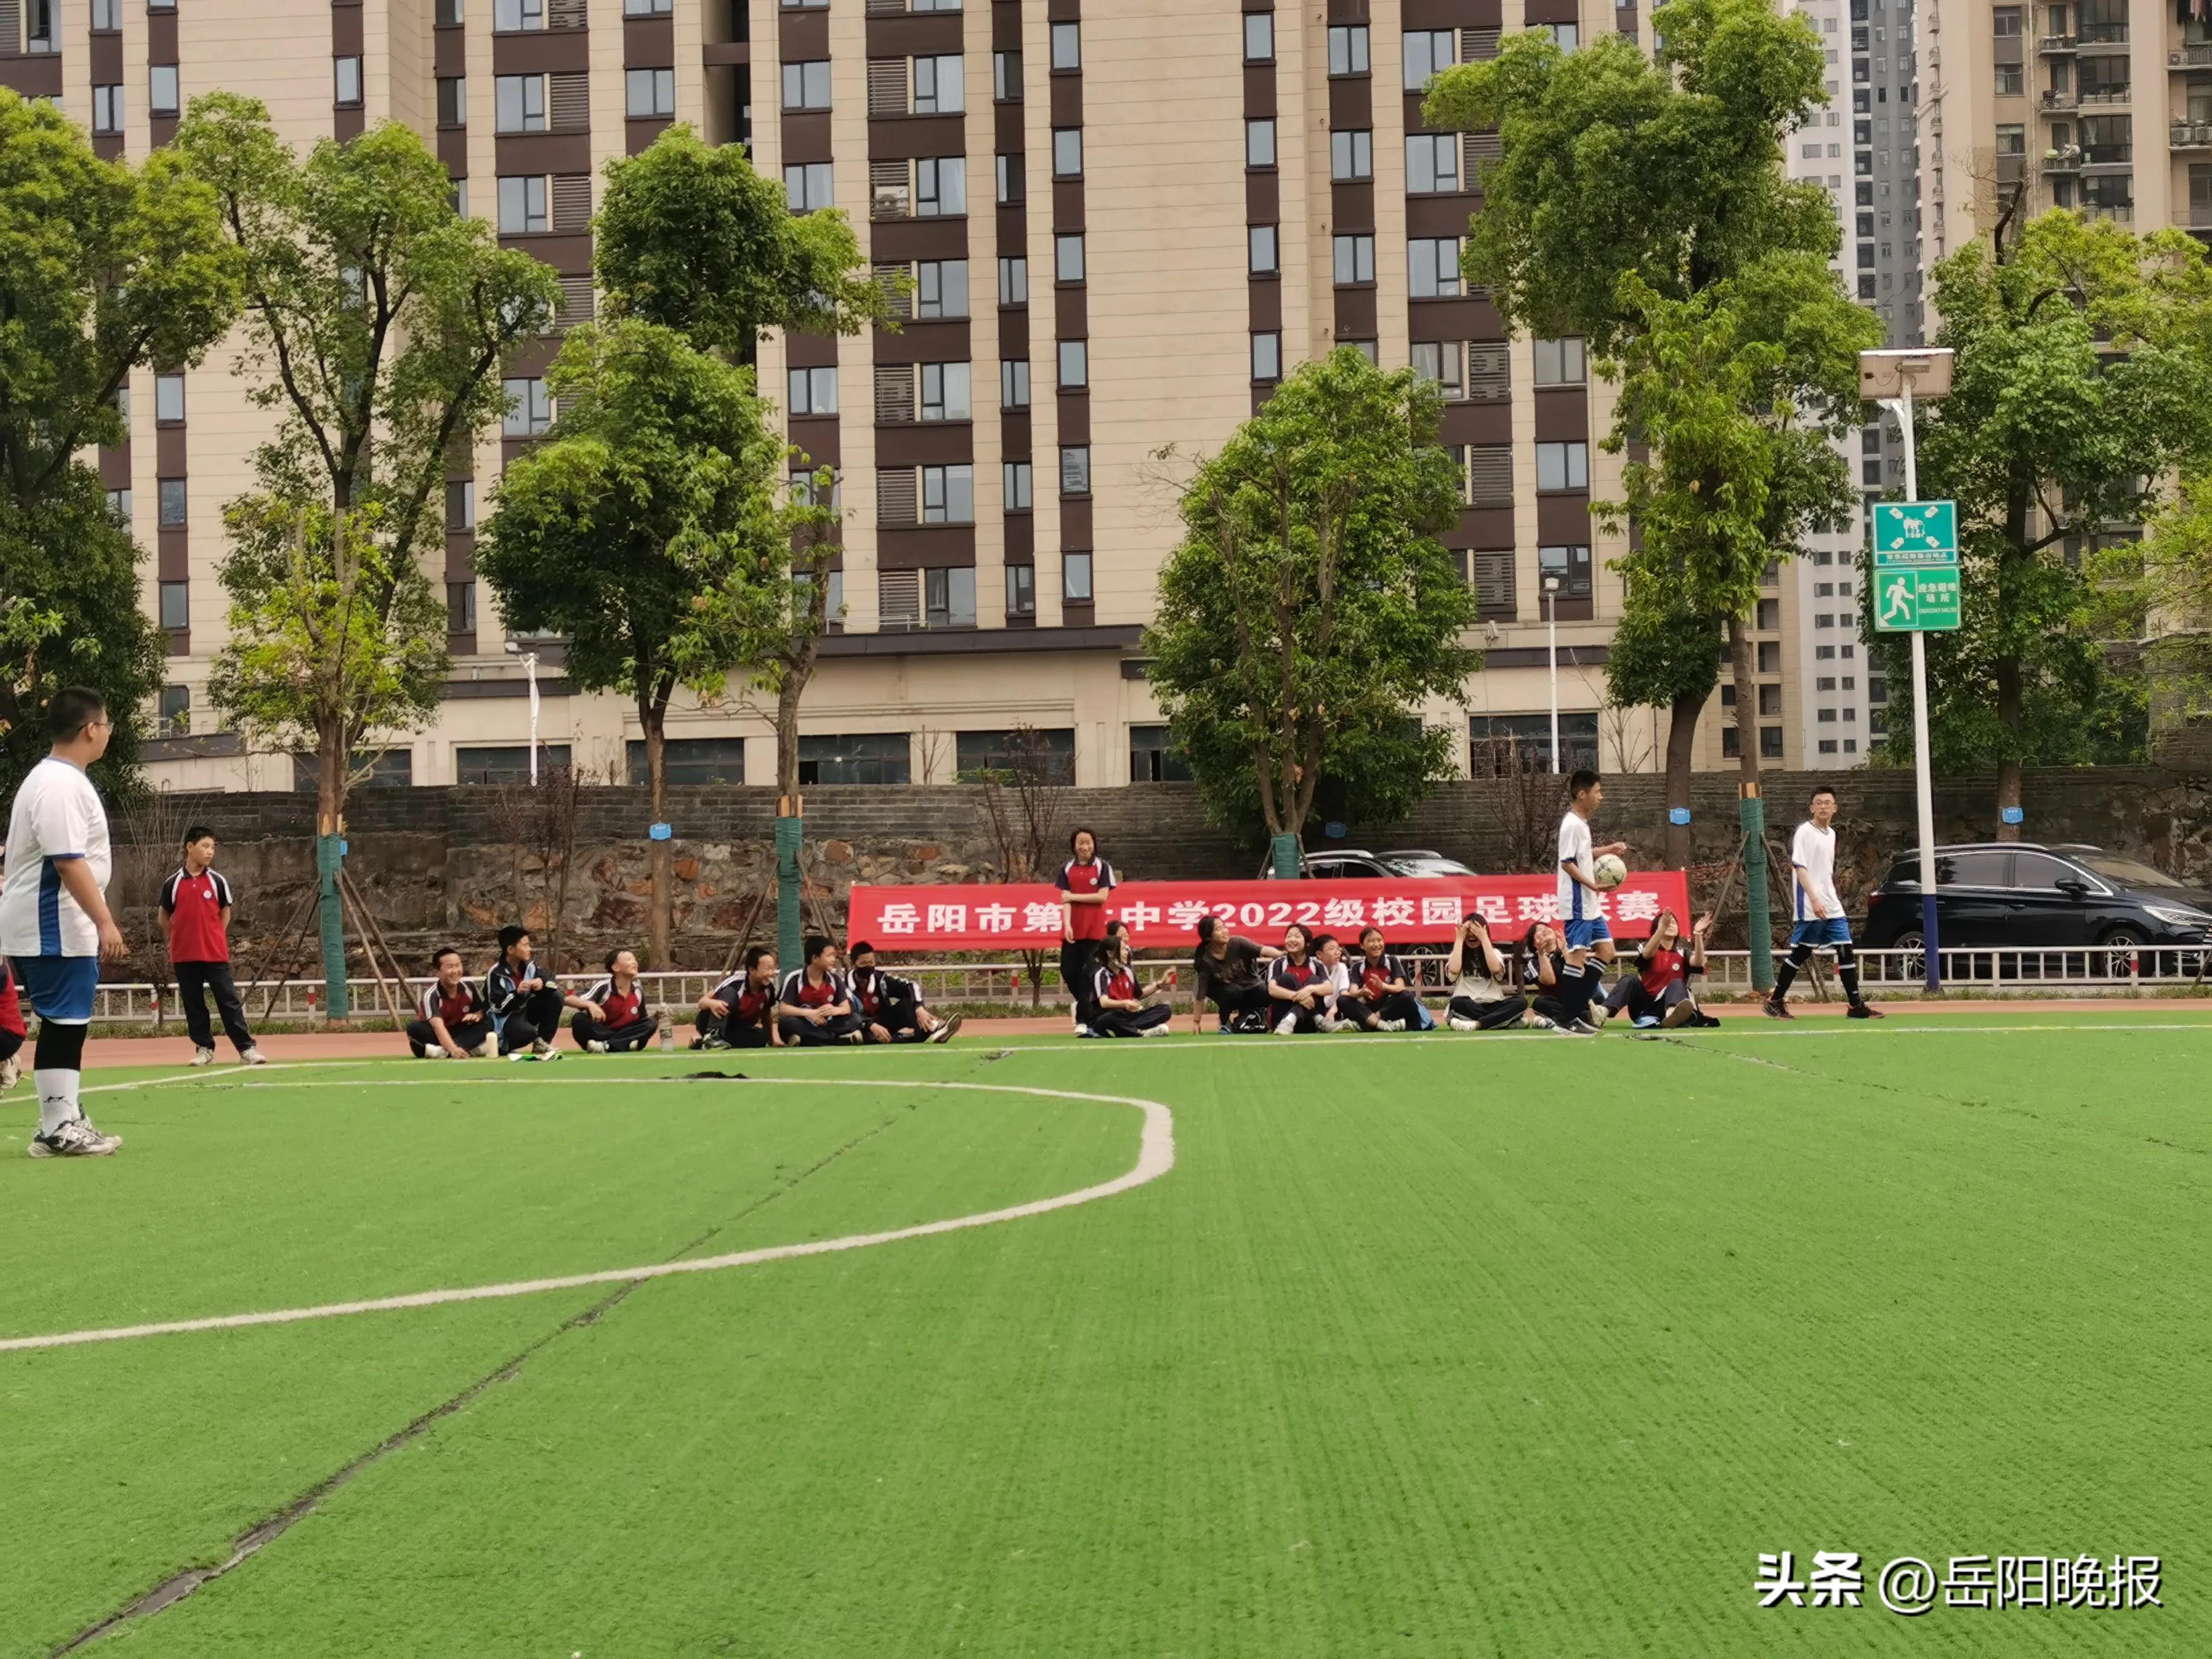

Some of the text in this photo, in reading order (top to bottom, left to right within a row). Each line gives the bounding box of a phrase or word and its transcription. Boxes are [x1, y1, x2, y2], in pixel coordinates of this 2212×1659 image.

[1919, 583, 1957, 592] 应急避难
[877, 890, 1661, 934] 岳阳市第中学2022级校园足球赛
